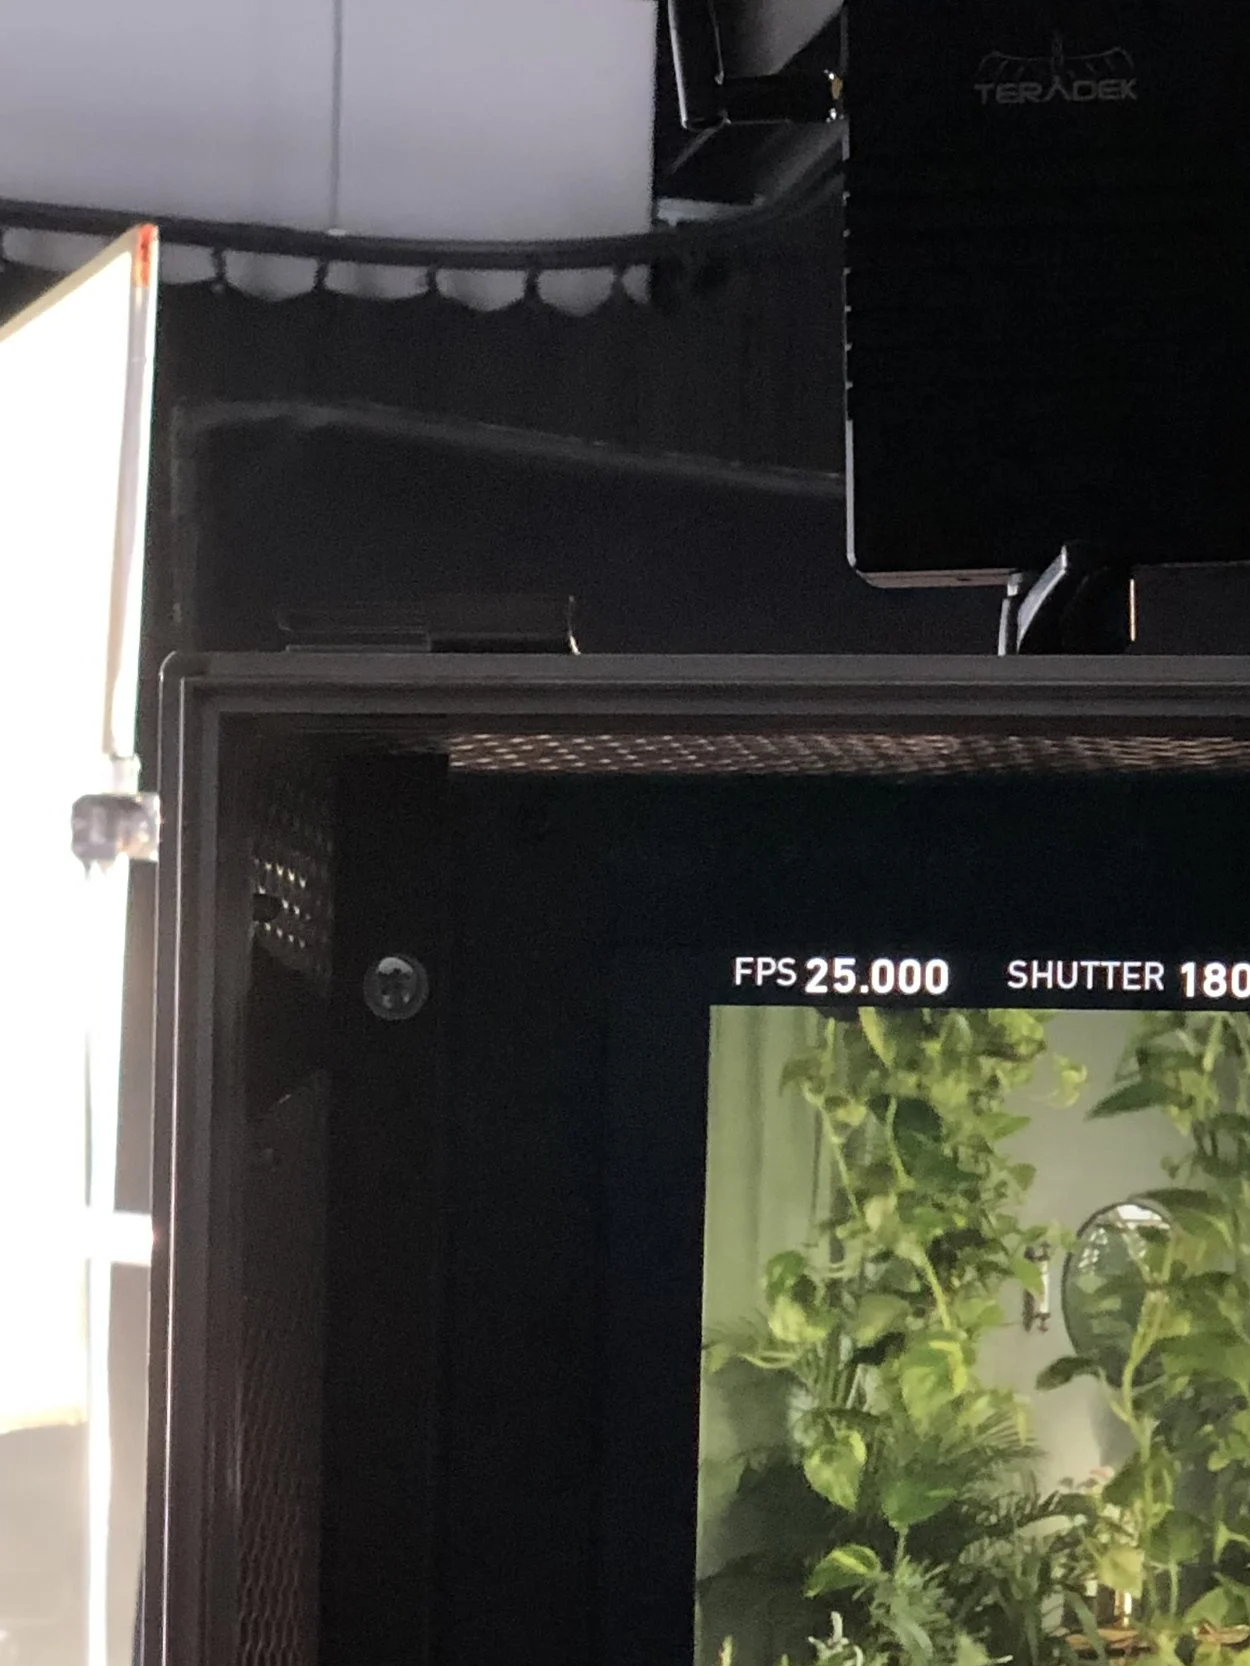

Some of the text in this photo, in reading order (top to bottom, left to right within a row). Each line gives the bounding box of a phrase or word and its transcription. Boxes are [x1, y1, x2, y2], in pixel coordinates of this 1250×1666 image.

[973, 75, 1140, 105] TERADEK
[734, 956, 949, 996] FPS 25.000
[1007, 959, 1165, 991] SHUTTER
